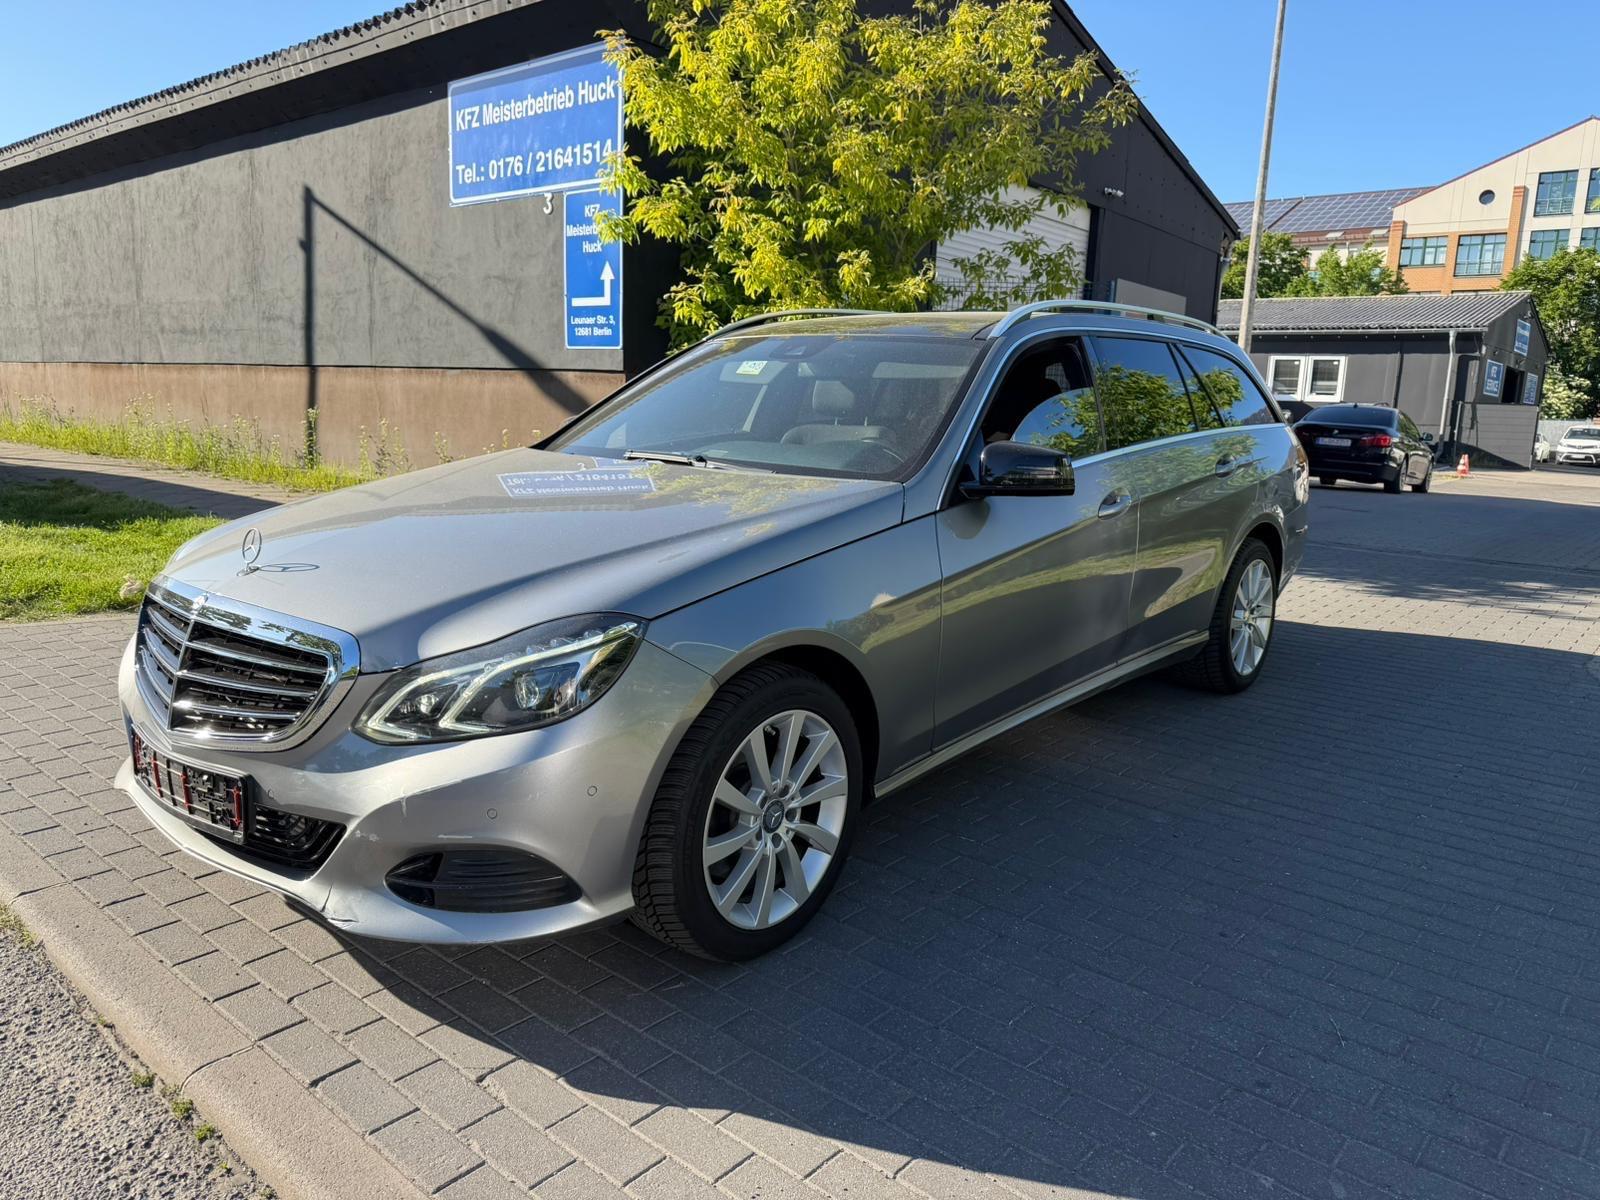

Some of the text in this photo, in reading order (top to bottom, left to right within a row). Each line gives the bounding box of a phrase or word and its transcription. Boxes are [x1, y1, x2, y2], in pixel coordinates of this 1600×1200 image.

[456, 75, 616, 131] KFZ Meisterbetrieb Huck
[455, 138, 612, 185] Tel.: 0176 / 21641514
[543, 192, 553, 214] 3
[582, 239, 602, 253] Huck
[570, 314, 616, 326] Leunaer Str. 3,
[593, 326, 612, 336] Berlin
